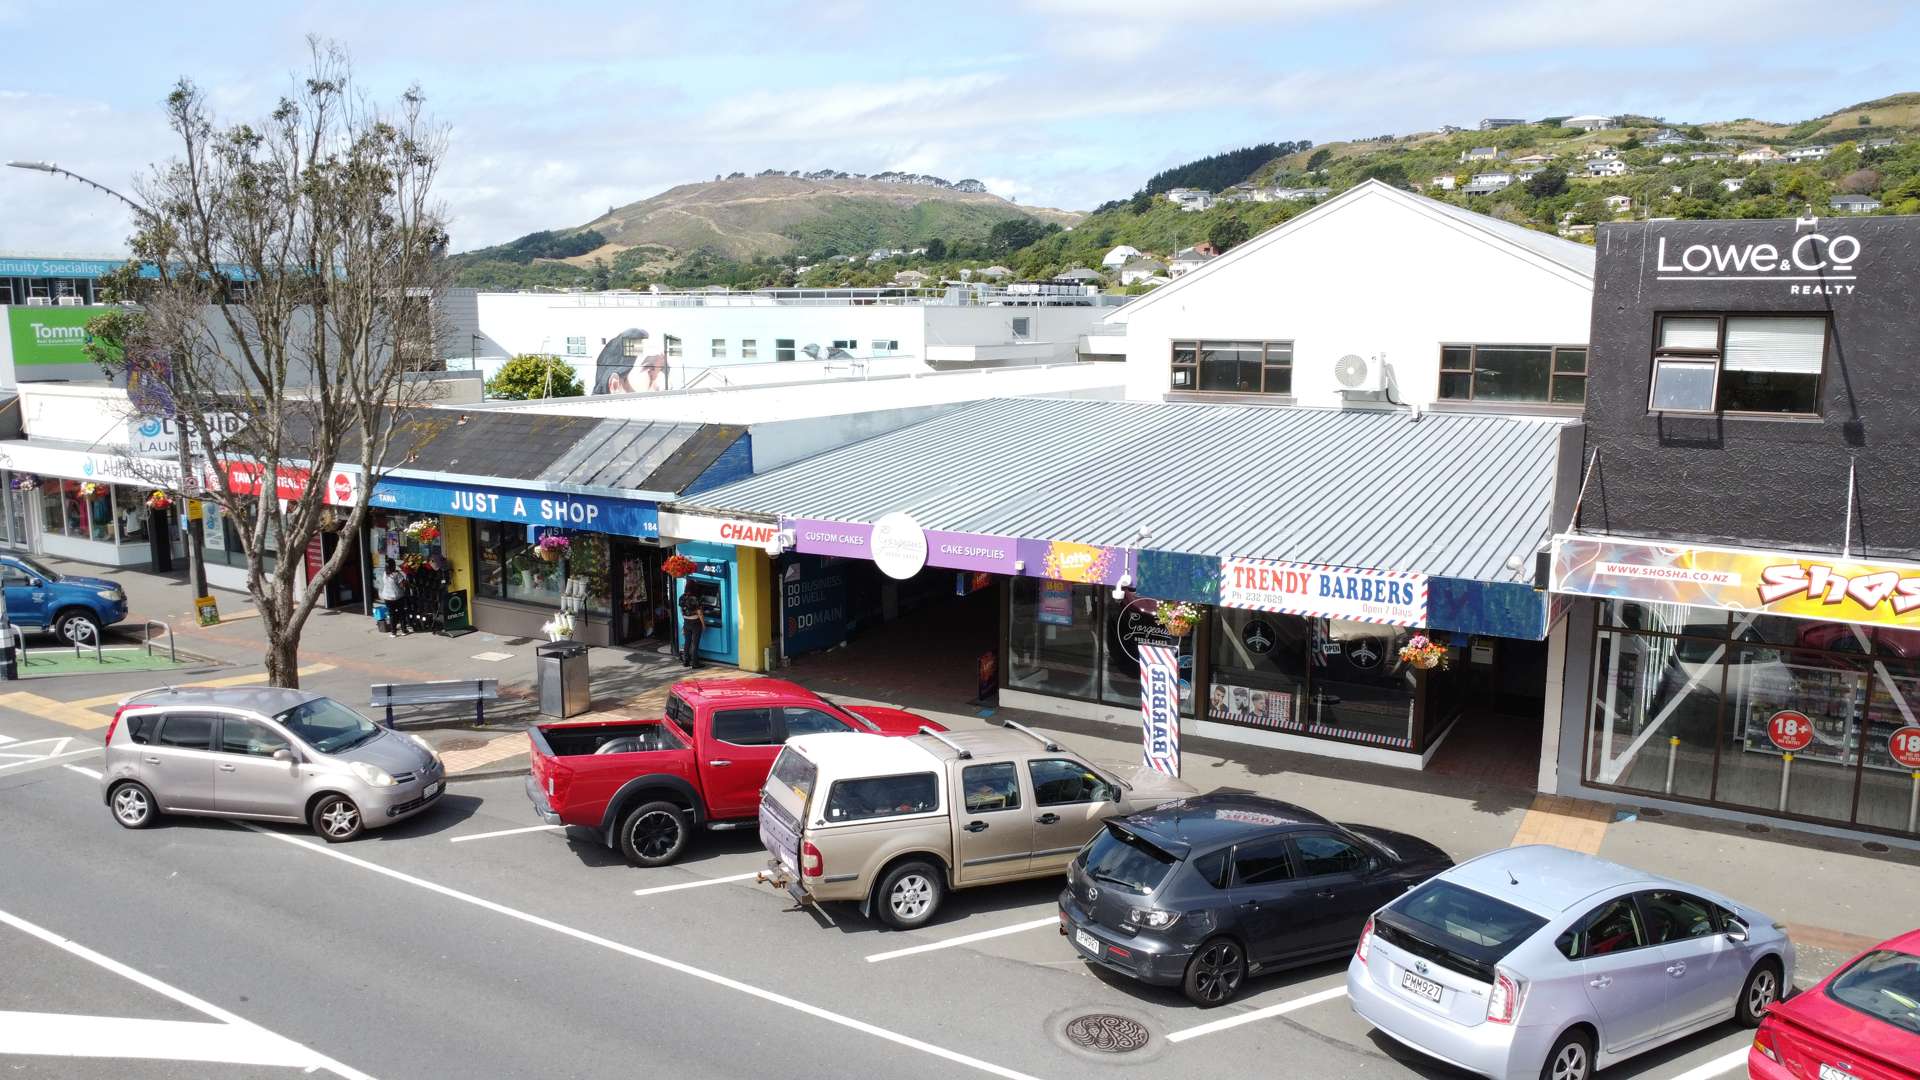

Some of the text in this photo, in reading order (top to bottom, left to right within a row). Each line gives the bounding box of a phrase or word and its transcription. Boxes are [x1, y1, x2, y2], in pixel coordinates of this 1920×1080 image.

[43, 262, 104, 275] Specialists
[1791, 285, 1855, 295] REALTY
[31, 324, 84, 338] Tomm
[379, 494, 397, 503] TAWA
[451, 491, 599, 524] JUST A SHOP
[643, 523, 658, 531] 184
[805, 532, 864, 545] CUSTOM CAKES
[940, 544, 1004, 559] CAKE SUPPLIES
[1606, 564, 1729, 583] WWW.SHOSHA.CO.NZ
[1233, 566, 1413, 605] TRENDY BARBERS
[1231, 591, 1242, 599] Ph
[1245, 592, 1261, 602] 232
[1362, 603, 1412, 618] Open 7 Days
[1124, 613, 1170, 640] Gorgeou
[1325, 645, 1340, 653] OPEN
[1152, 668, 1168, 753] BARBER
[1775, 718, 1809, 736] 18+
[1405, 972, 1441, 998] PMM927
